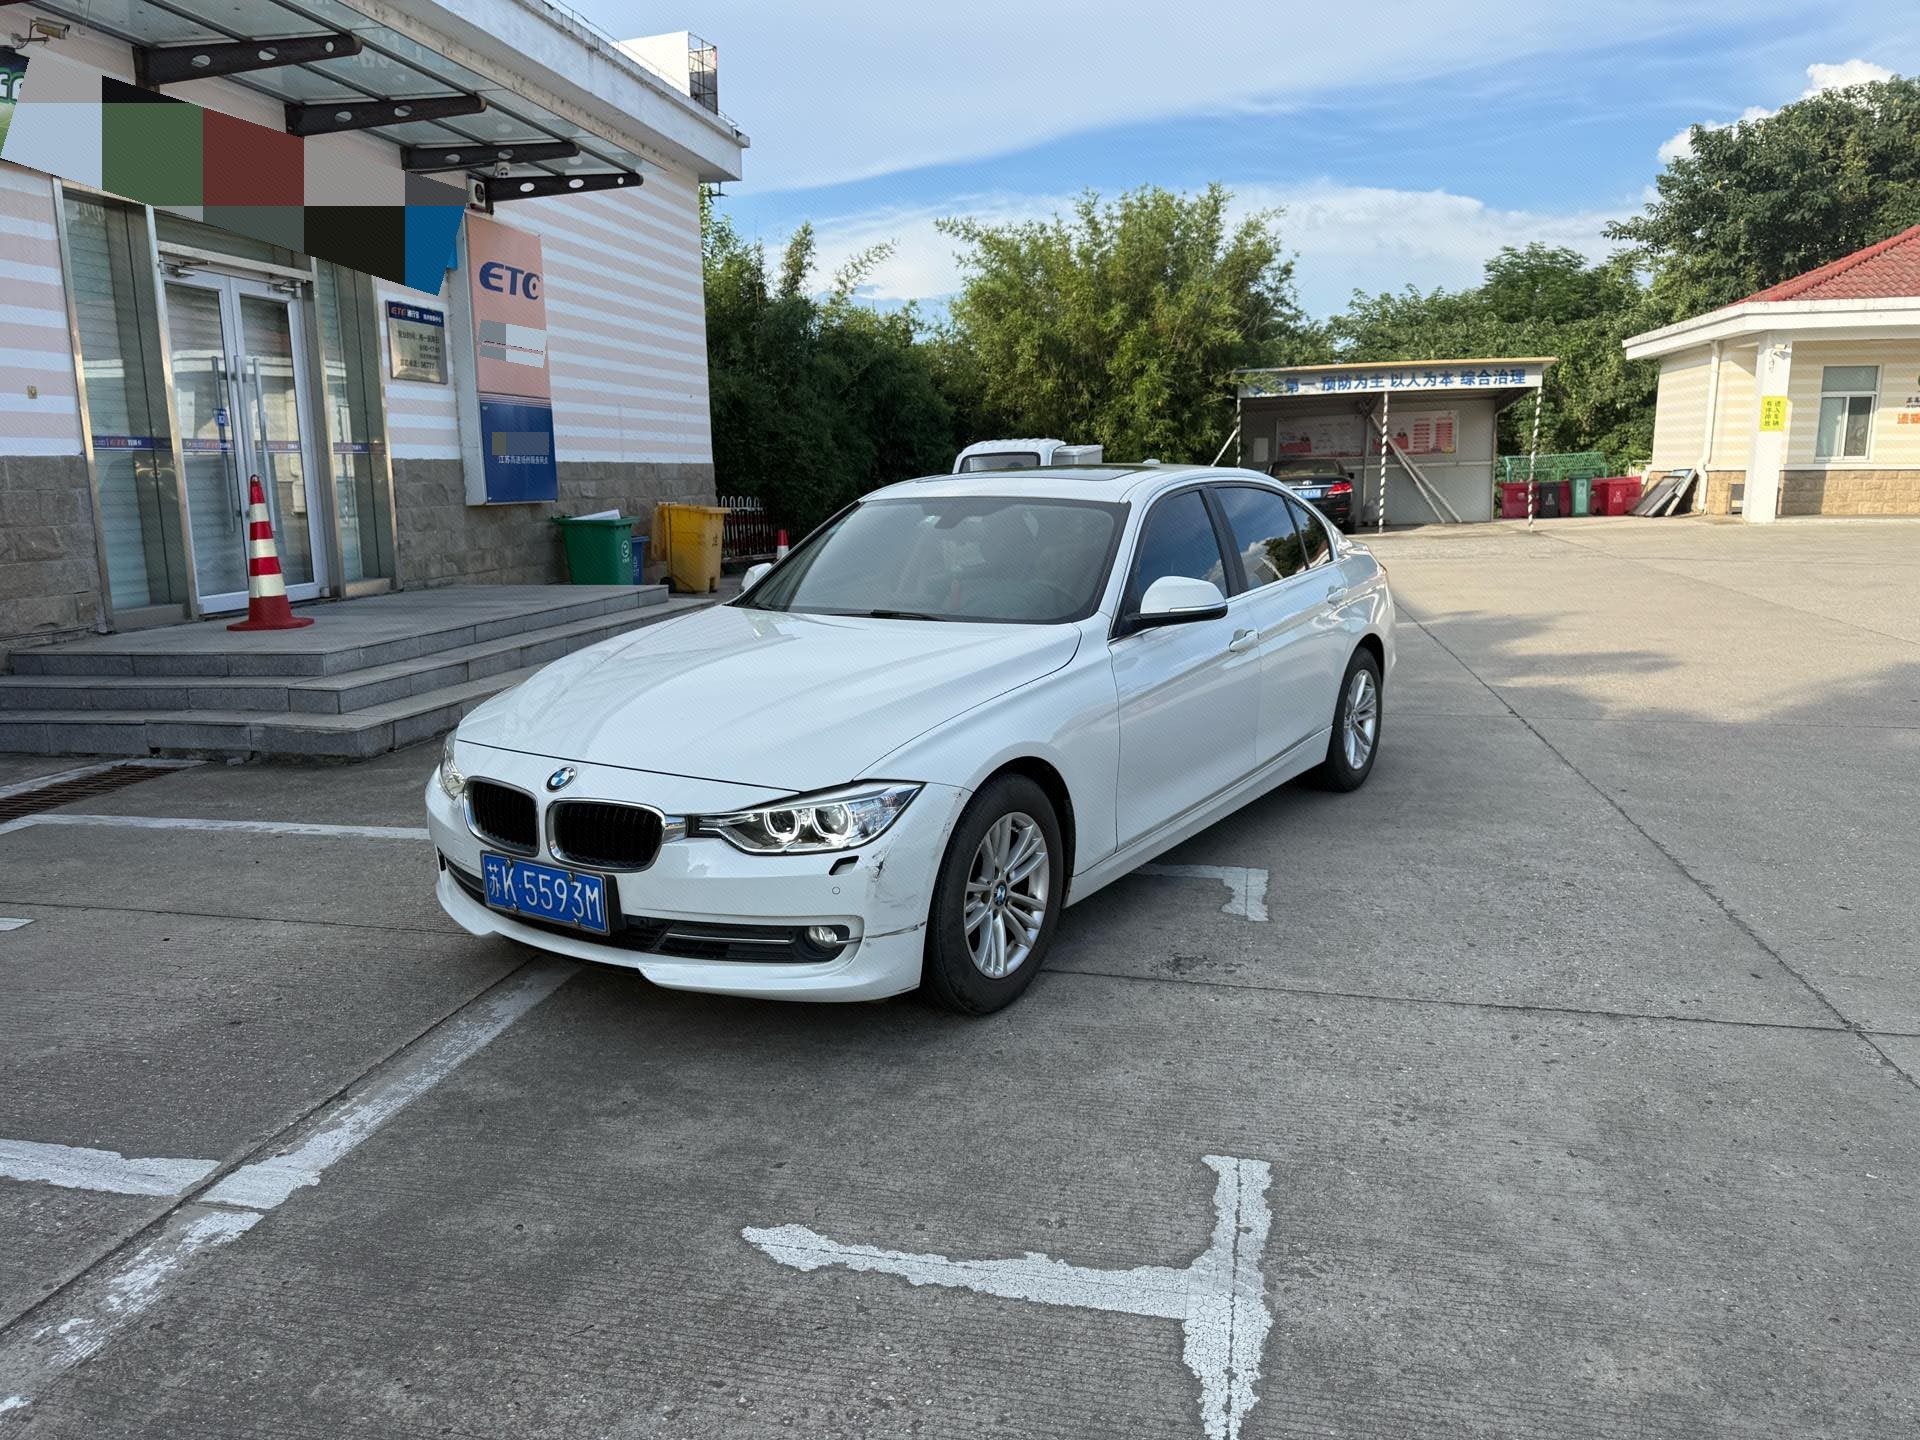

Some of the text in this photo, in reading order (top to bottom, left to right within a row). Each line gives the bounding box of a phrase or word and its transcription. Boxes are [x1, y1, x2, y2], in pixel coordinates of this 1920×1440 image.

[479, 261, 541, 300] ETC
[1321, 373, 1385, 391] 预防为主
[1390, 370, 1454, 388] 以人为本
[1460, 368, 1526, 386] 综合治理
